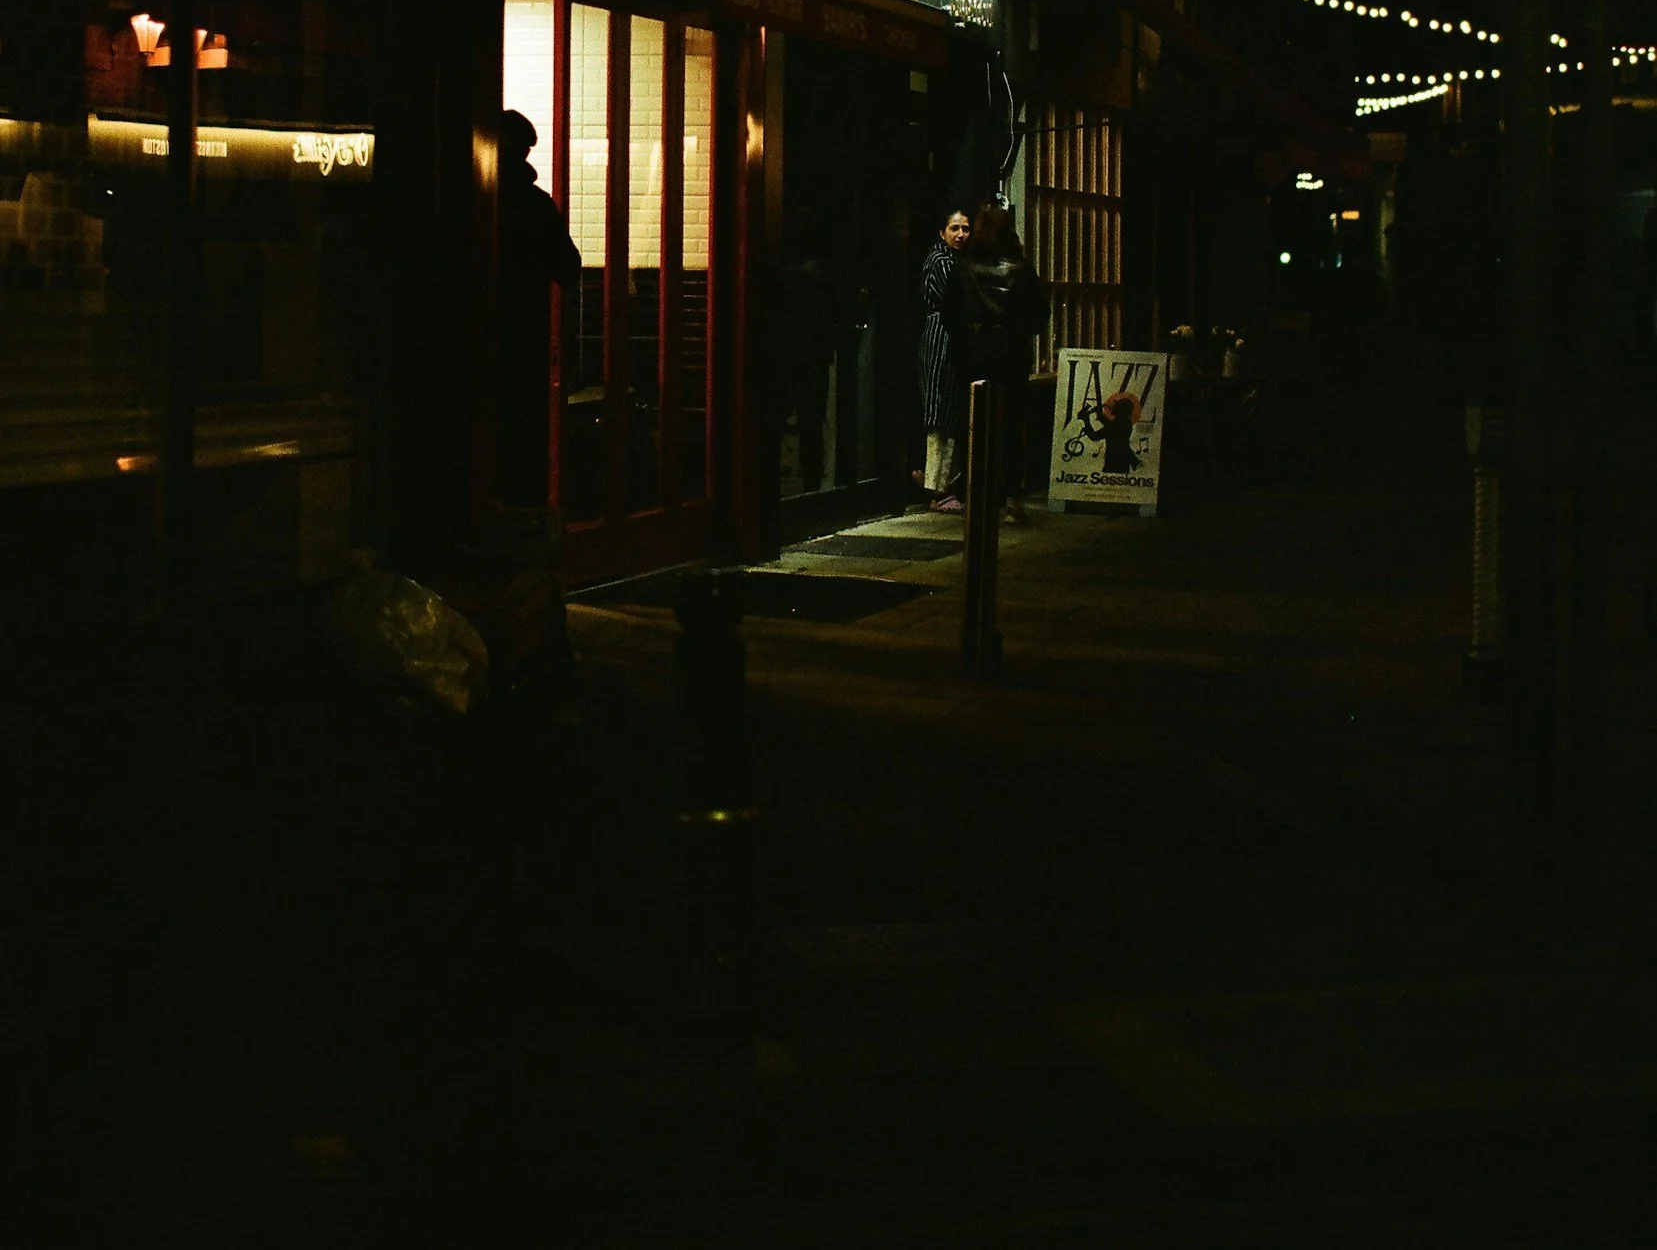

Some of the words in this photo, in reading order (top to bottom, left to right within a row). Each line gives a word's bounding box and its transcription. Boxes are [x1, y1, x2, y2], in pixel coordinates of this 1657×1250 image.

[1062, 359, 1159, 431] JAZZ
[1056, 471, 1089, 485] Jazz
[1090, 472, 1155, 488] Sessions
